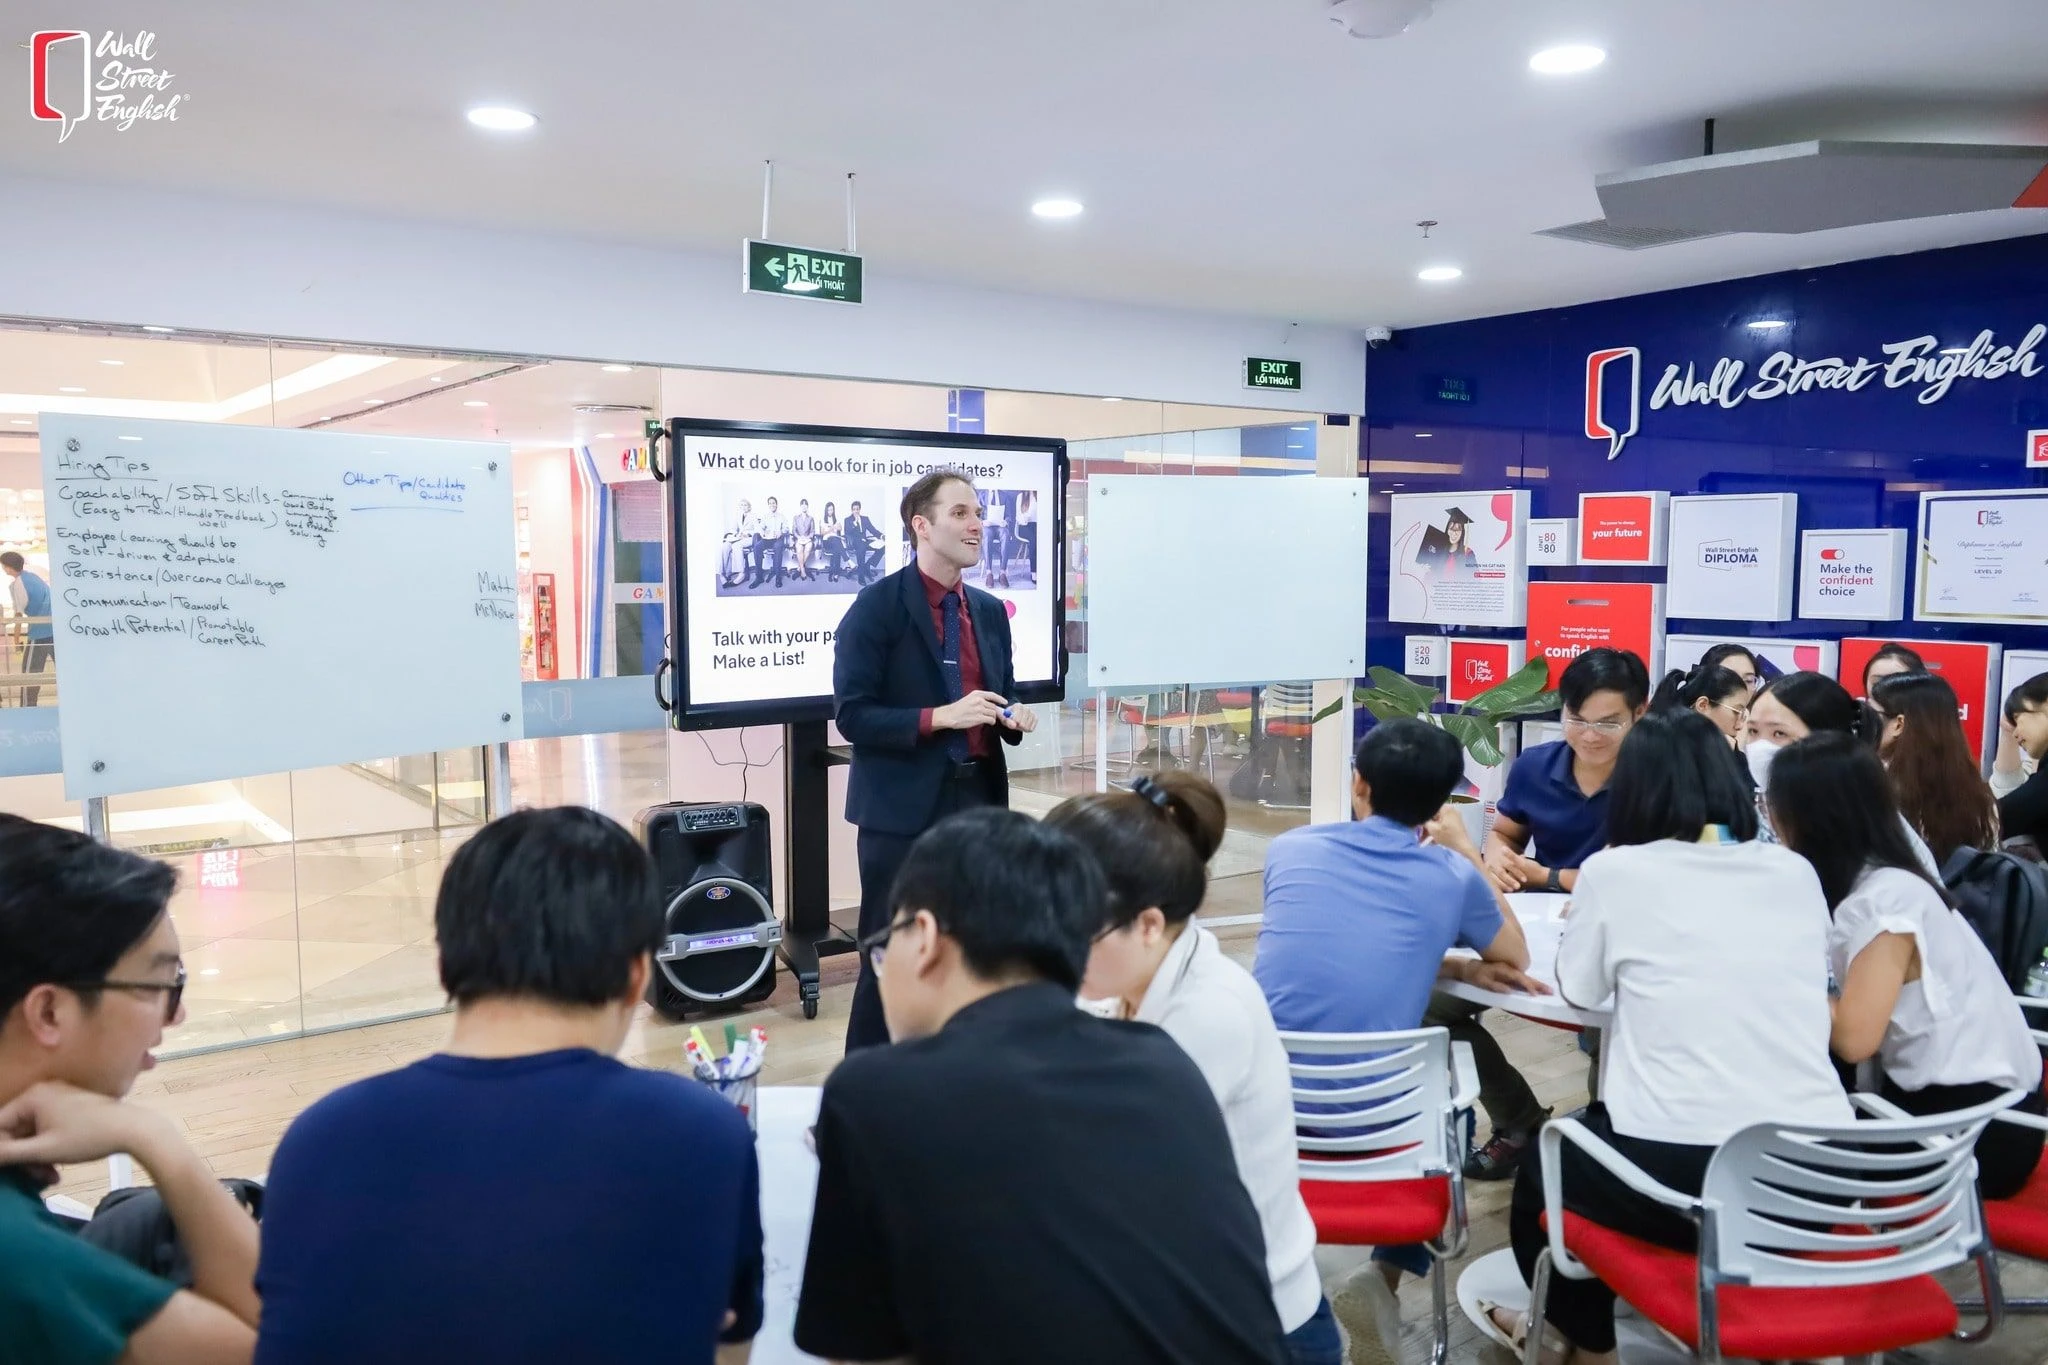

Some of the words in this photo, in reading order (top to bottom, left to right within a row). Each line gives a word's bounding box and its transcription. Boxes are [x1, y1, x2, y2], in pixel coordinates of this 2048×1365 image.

[811, 258, 845, 277] EXIT
[824, 279, 845, 291] THOÁT
[1260, 361, 1288, 374] EXIT
[1650, 357, 1746, 410] Wall
[1747, 350, 1883, 400] Street
[1881, 323, 2047, 405] English
[1255, 373, 1268, 384] LỐI
[1268, 376, 1294, 386] THOÁT
[57, 453, 111, 481] Hiring
[105, 456, 150, 473] Tips
[698, 452, 745, 469] What
[749, 454, 770, 470] do
[774, 459, 804, 473] you
[808, 457, 843, 473] look
[846, 458, 869, 473] for
[872, 459, 886, 474] in
[888, 460, 913, 477] job
[343, 471, 381, 486] Other
[124, 504, 135, 514] to
[199, 520, 227, 529] well
[1544, 532, 1556, 542] 80
[1592, 529, 1614, 540] your
[1615, 527, 1643, 538] future
[120, 530, 177, 553] Learning
[179, 533, 215, 548] should
[219, 535, 238, 549] be
[1543, 543, 1556, 554] 80
[176, 551, 236, 566] adaptable
[1704, 553, 1758, 563] DIPLOMA
[1820, 563, 1851, 574] Make
[1854, 563, 1873, 574] the
[226, 573, 286, 595] Challenges
[477, 570, 515, 594] Matt
[1819, 575, 1874, 586] confident
[1819, 585, 1856, 596] choice
[69, 614, 127, 636] Growth
[198, 632, 235, 646] Career
[711, 631, 745, 646] Talk
[748, 630, 782, 645] with
[786, 630, 820, 646] your
[1420, 646, 1430, 655] 20
[713, 653, 756, 669] Make
[760, 656, 769, 667] a
[773, 651, 805, 666] List!
[1419, 656, 1430, 665] 20
